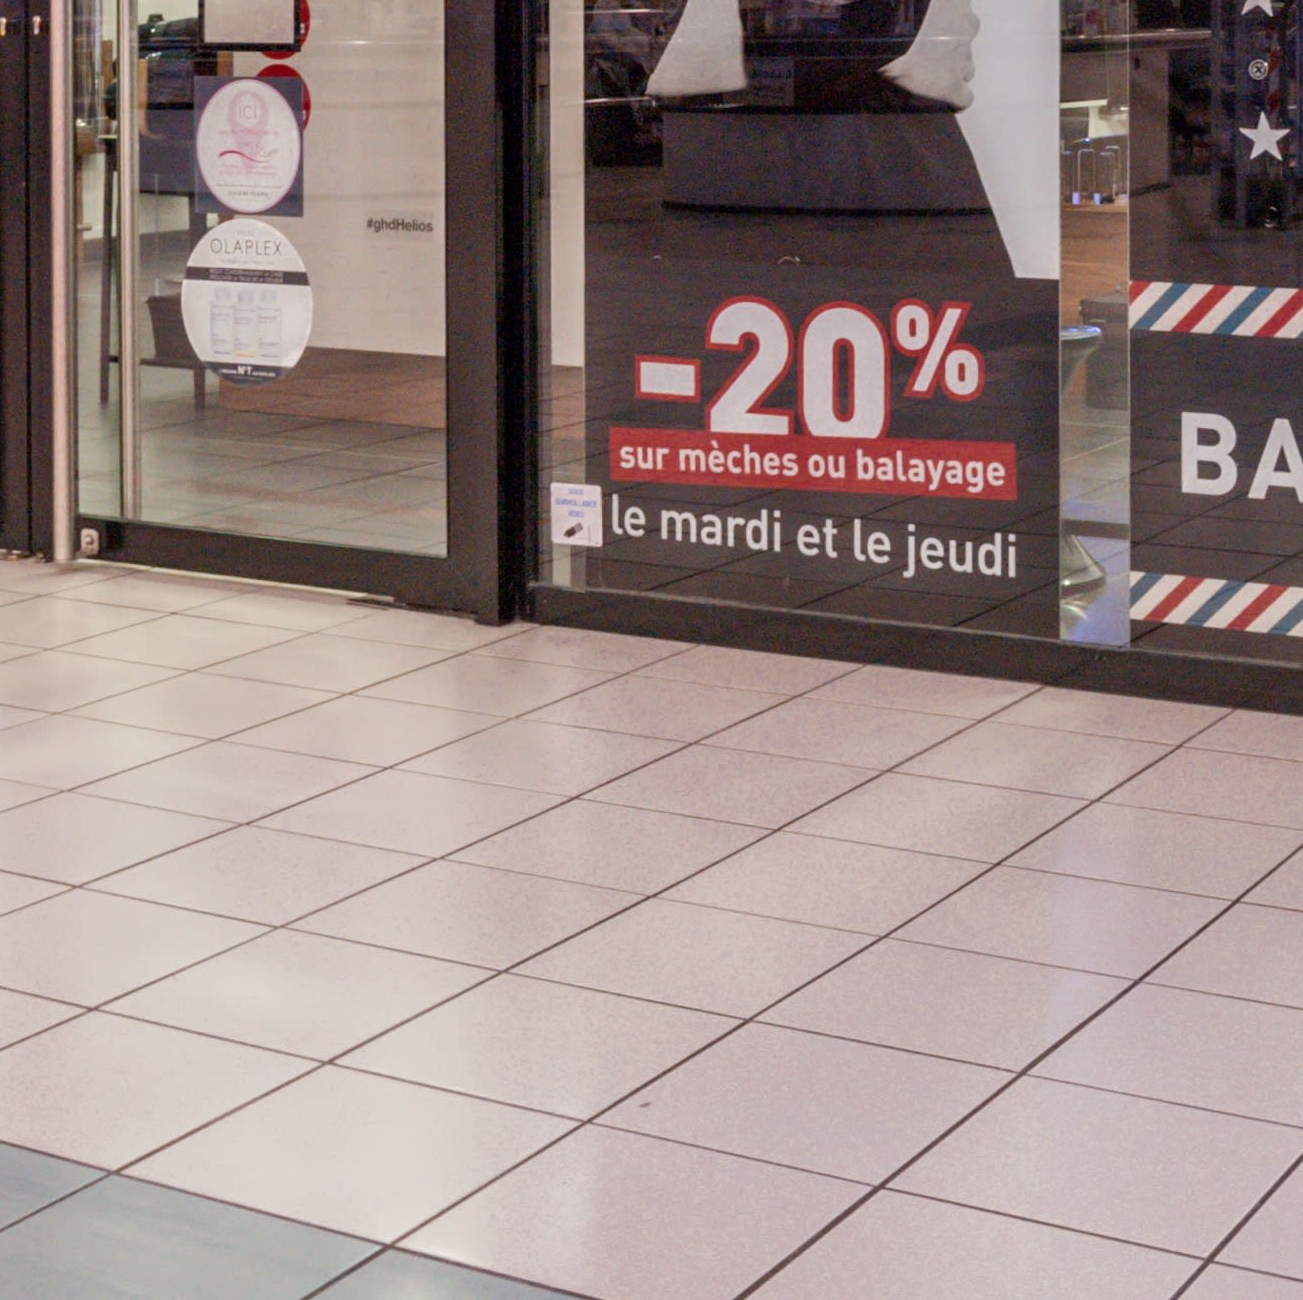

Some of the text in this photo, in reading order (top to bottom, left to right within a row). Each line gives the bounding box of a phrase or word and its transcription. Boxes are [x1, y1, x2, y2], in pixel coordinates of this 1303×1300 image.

[210, 237, 283, 256] OLAPLEX
[366, 218, 434, 234] #ghdHelios
[638, 299, 983, 438] -20%
[619, 436, 1006, 493] sur mèches ou balayage
[612, 495, 1016, 578] le mardi et le jeudi
